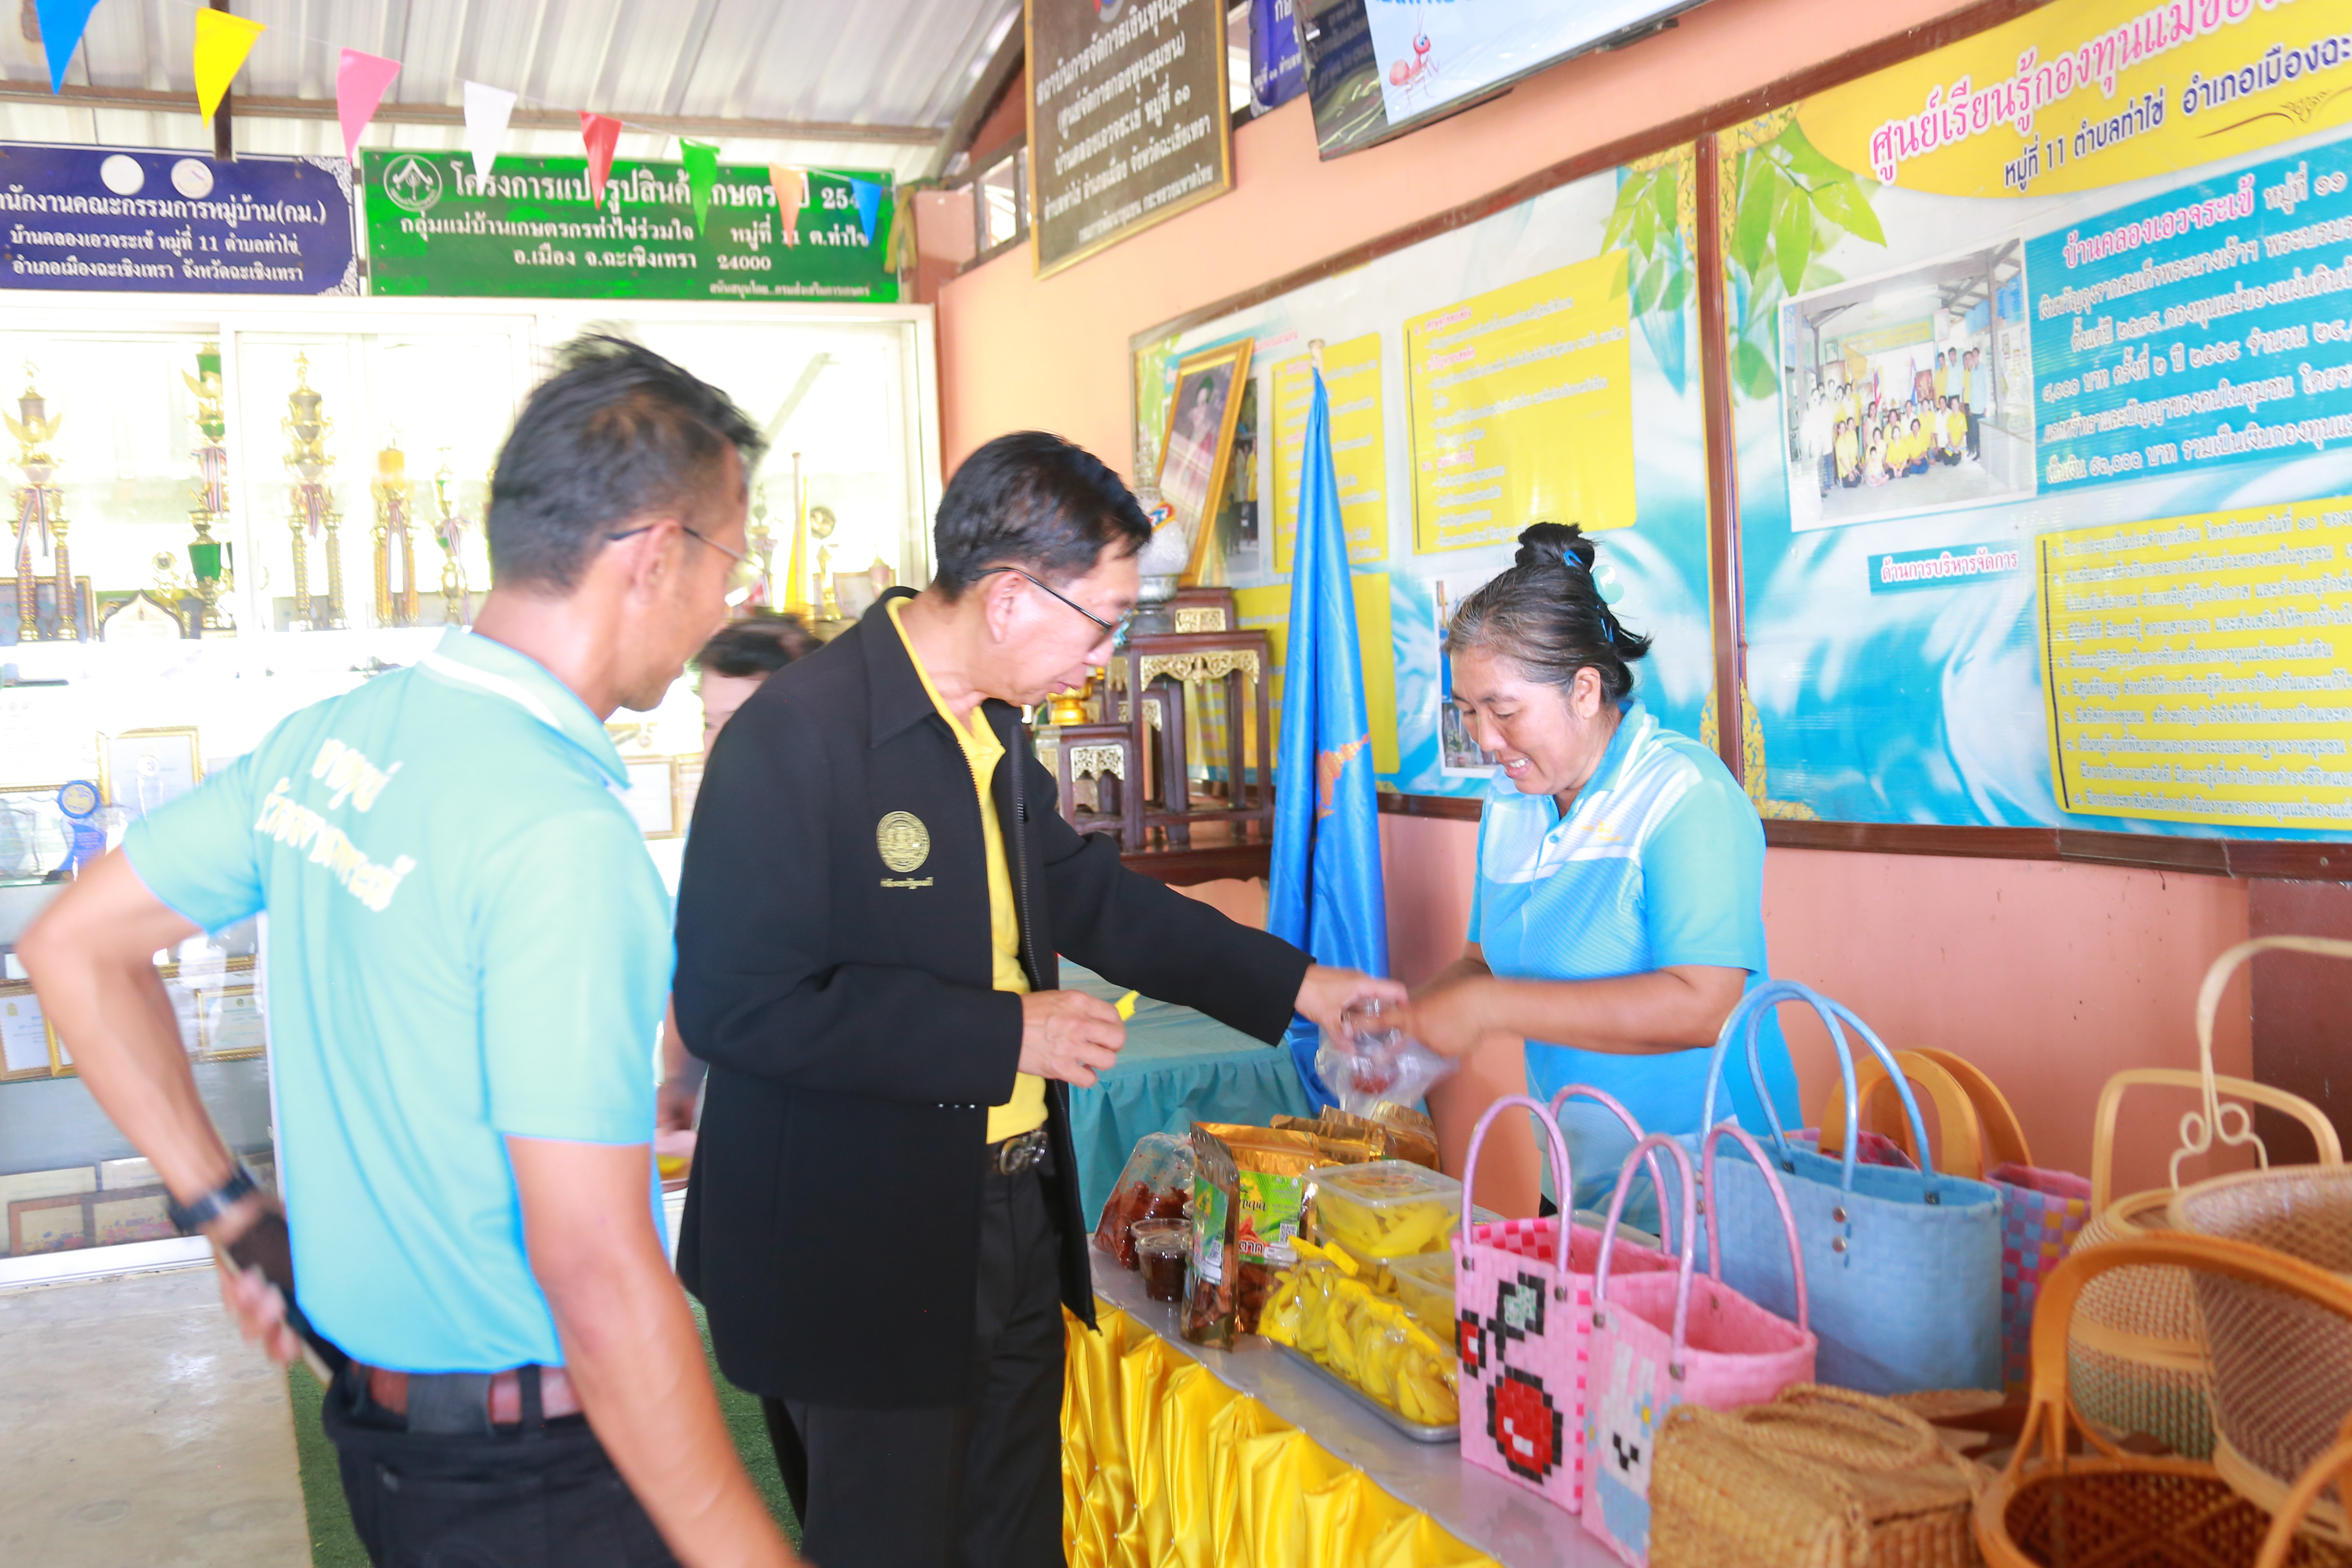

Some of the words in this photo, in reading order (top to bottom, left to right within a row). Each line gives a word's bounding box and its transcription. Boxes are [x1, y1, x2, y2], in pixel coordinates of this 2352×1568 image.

[1144, 72, 1170, 128] หมู่ที่
[1173, 84, 1191, 107] ๑๑
[2005, 135, 2039, 192] หมู่ที่
[2046, 138, 2066, 170] 11
[2074, 87, 2164, 158] ตำบลท่าไข่
[1044, 178, 1081, 222] ตำบลท่าไข่
[1082, 156, 1128, 200] อำเภอเมือง
[1130, 114, 1211, 174] จังหวัดฉะเชิงเทรา
[9, 223, 154, 250] บ้านคลองเอวจระเข้
[157, 224, 193, 257] หมู่ที่
[199, 235, 219, 252] 11
[224, 232, 303, 257] ตำบลท่าไข่
[400, 210, 694, 243] กลุ่มแม่บ้านเกษตรกรท่าไข่ร่วมใจ
[730, 214, 772, 251] หมู่ที่
[809, 224, 870, 247] ต.ท่าไข
[2064, 174, 2255, 269] บ้านคลองเอวจระเข้
[2263, 161, 2309, 214] หมู่ที่
[2314, 171, 2347, 196] ๑๑
[12, 253, 175, 279] อำเภอเมืองฉะเชิงเทรา
[182, 257, 304, 282] จังหวัดฉะเชิงเทรา
[513, 242, 577, 266] อ.เมือง
[585, 245, 697, 269] จ.ฉะเชิงเทรา
[717, 254, 772, 271] 24000
[2083, 368, 2110, 392] บาท
[2113, 343, 2150, 385] ครั้งที่
[2153, 356, 2167, 376] ๒
[2170, 342, 2185, 372] ปี
[2190, 340, 2240, 368] ๒๕๕๔
[2246, 324, 2308, 357] จำนวน
[2313, 319, 2352, 344] ๒๔,
[2046, 454, 2087, 484] เป็นเงิน
[2145, 442, 2178, 467] บาท
[2181, 413, 2352, 461] รวมเป็นเงินกองทุนแ
[1882, 547, 2018, 582] ด้านการบริหารจัดการ
